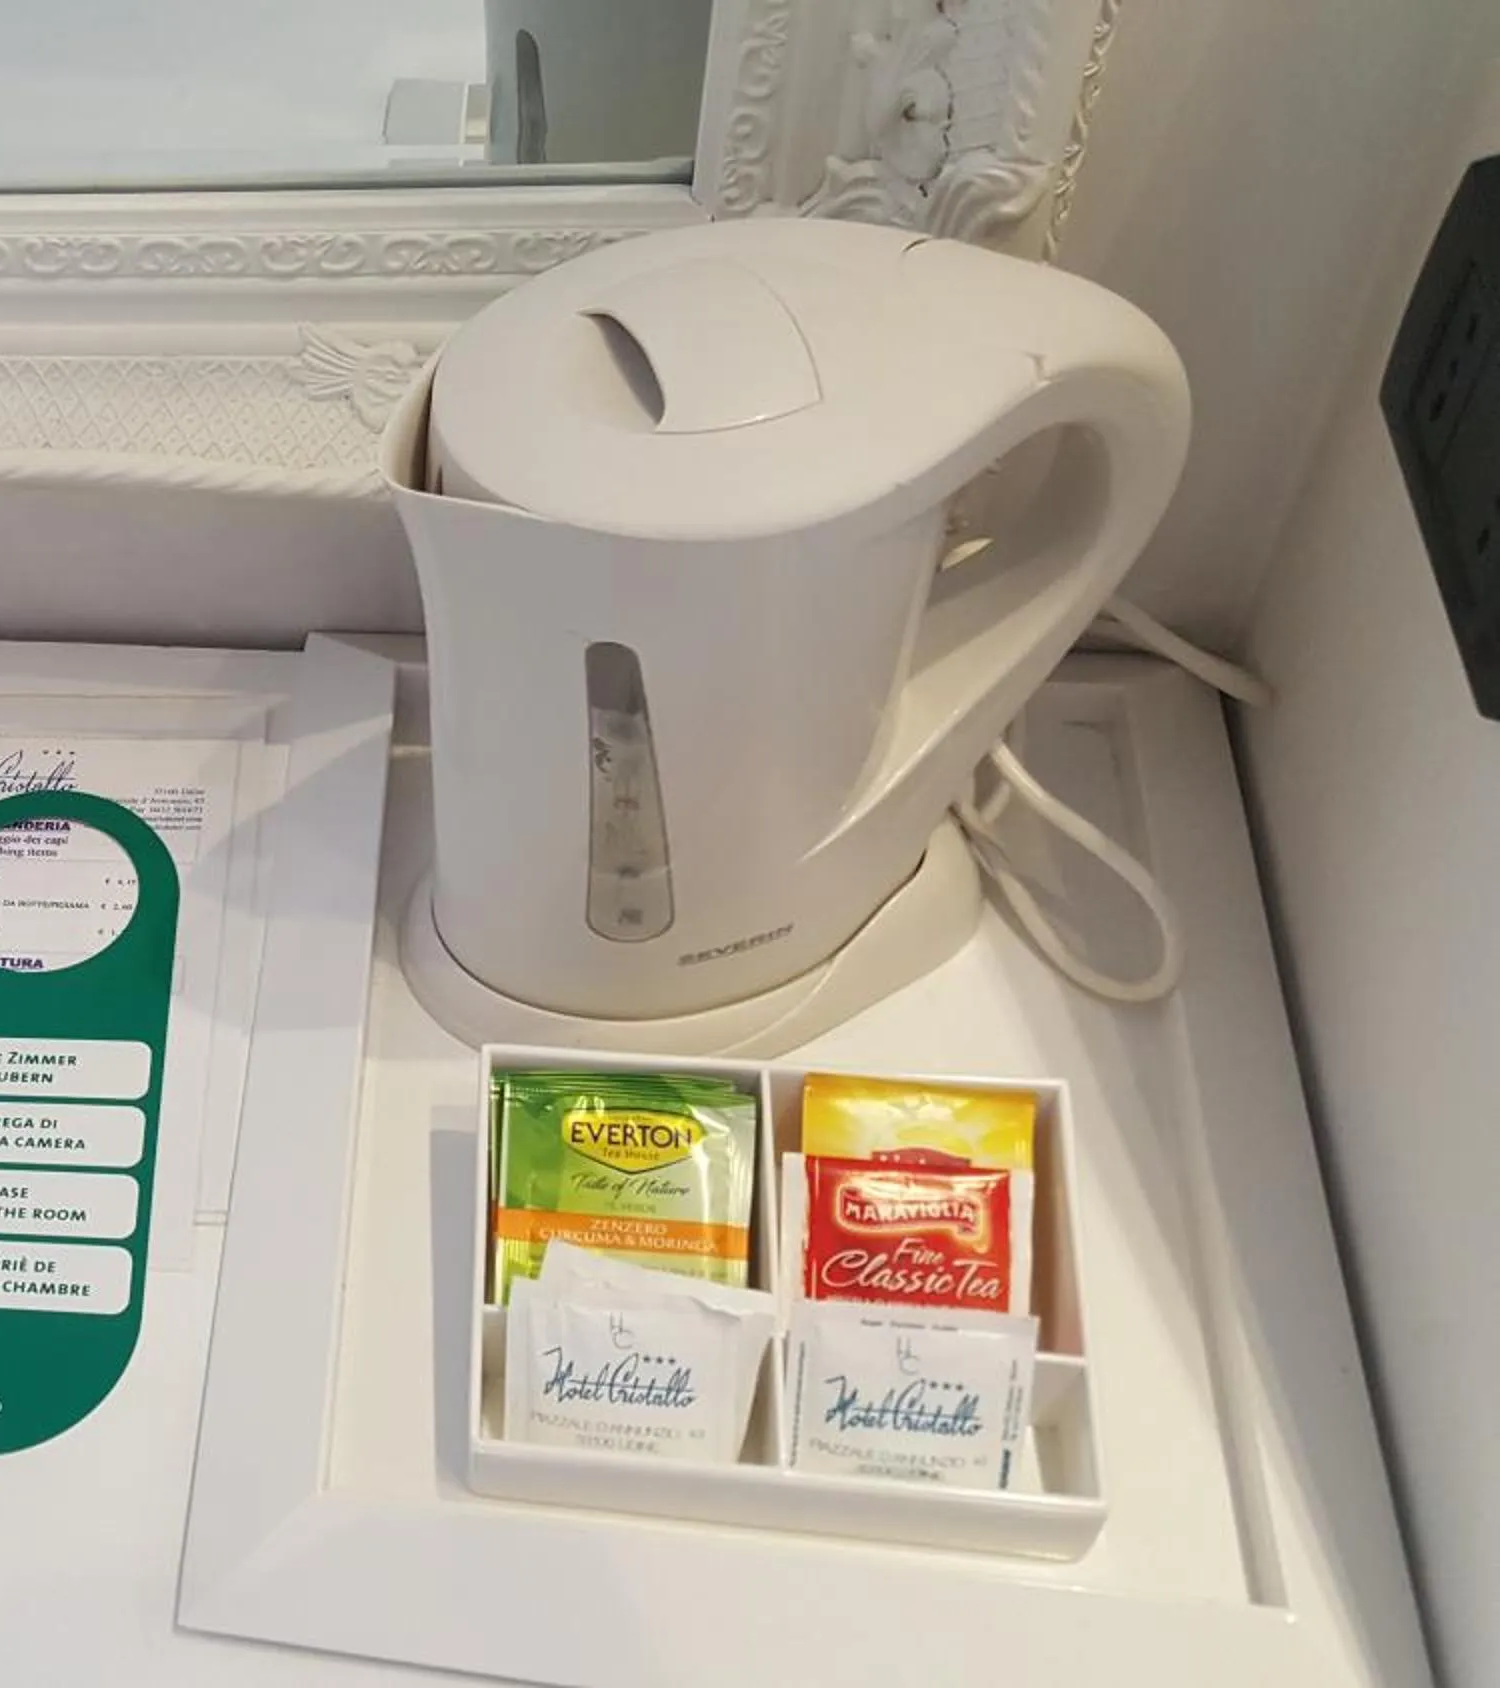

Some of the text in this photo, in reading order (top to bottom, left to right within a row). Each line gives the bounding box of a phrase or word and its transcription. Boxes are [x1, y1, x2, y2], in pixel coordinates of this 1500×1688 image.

[7, 1051, 77, 1066] ZIMMER
[39, 1118, 58, 1130] DI
[13, 1136, 86, 1150] CAMERA
[570, 1121, 692, 1150] EVERTON
[32, 1208, 88, 1222] ROOM
[589, 1219, 668, 1235] ZENZERO
[892, 1237, 944, 1266] Fine
[33, 1260, 57, 1274] DE
[821, 1249, 1002, 1300] Classic Tea
[2, 1280, 92, 1297] CHAMBRE
[542, 1346, 698, 1409] Hotel Cristallo
[824, 1375, 896, 1432] Hotel
[893, 1378, 984, 1437] Cristallo
